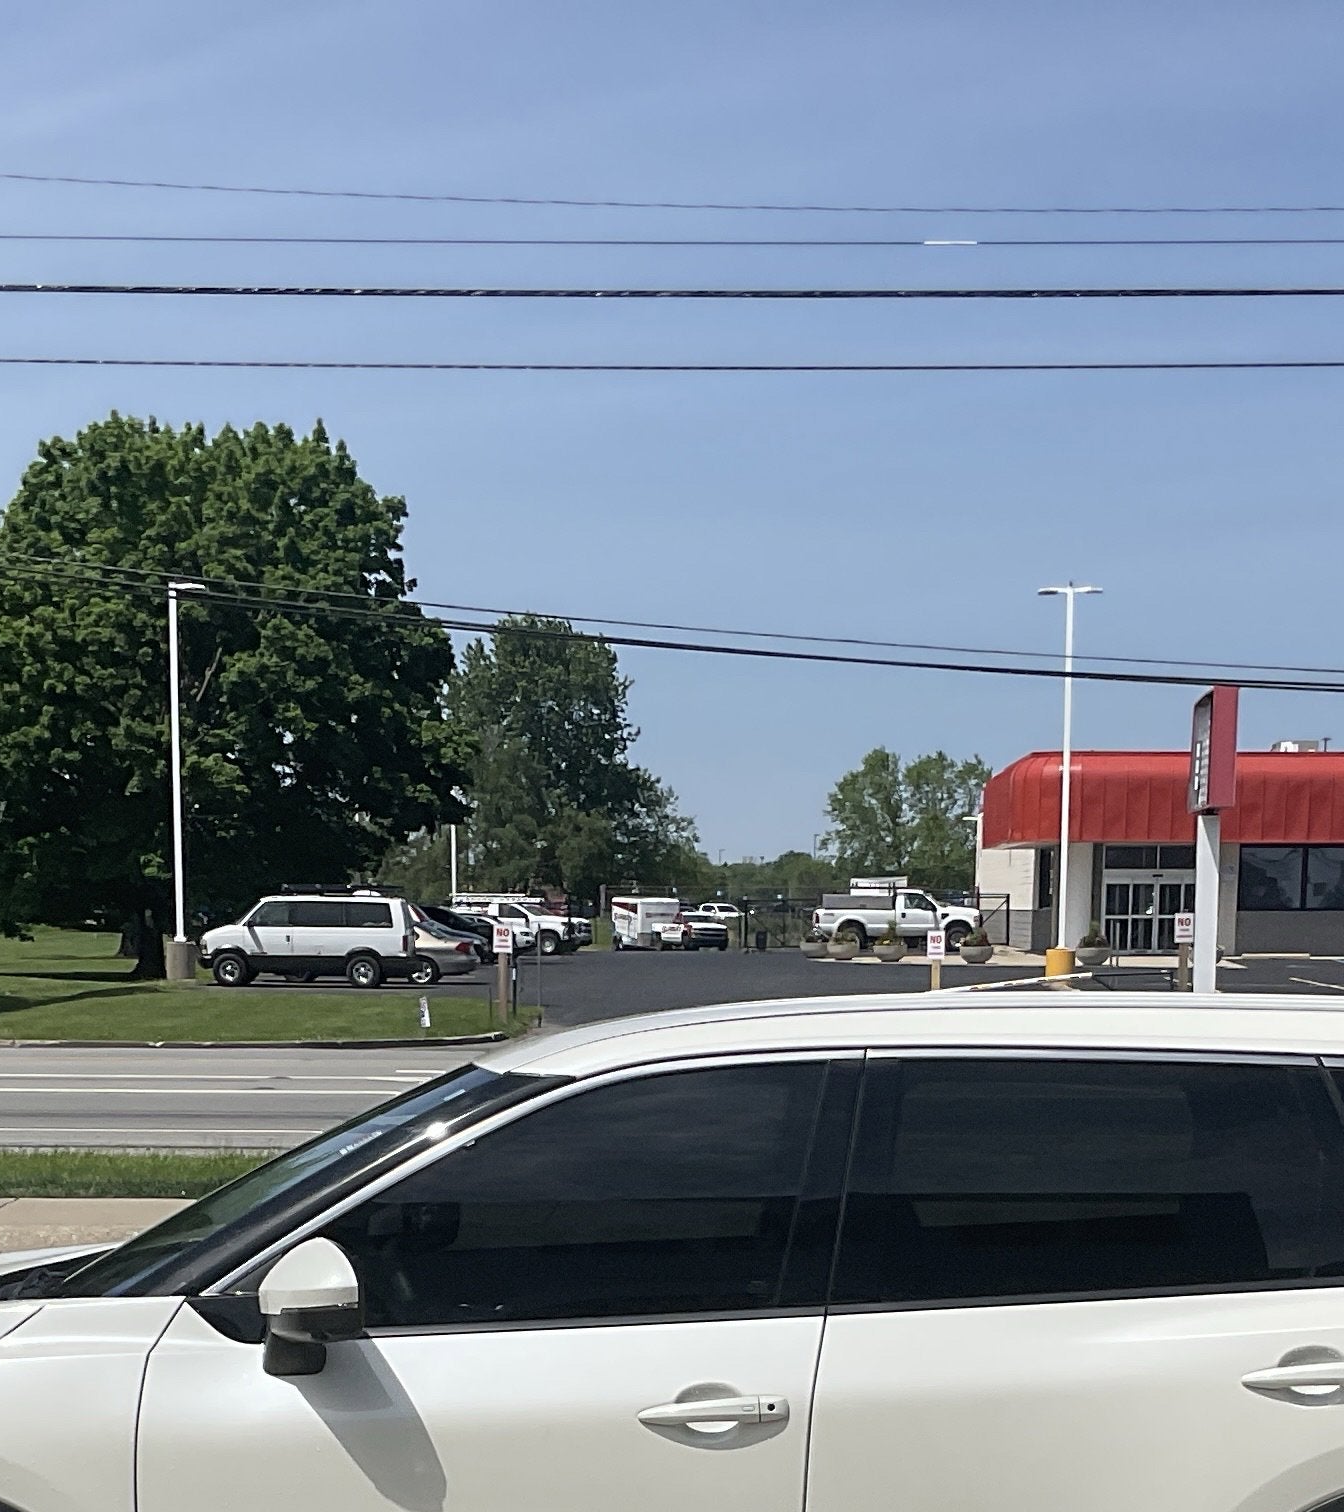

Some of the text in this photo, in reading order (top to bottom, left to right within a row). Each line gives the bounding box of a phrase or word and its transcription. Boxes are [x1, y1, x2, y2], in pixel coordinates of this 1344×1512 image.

[1177, 917, 1191, 927] NO
[496, 928, 510, 937] NO
[929, 935, 942, 944] NO
